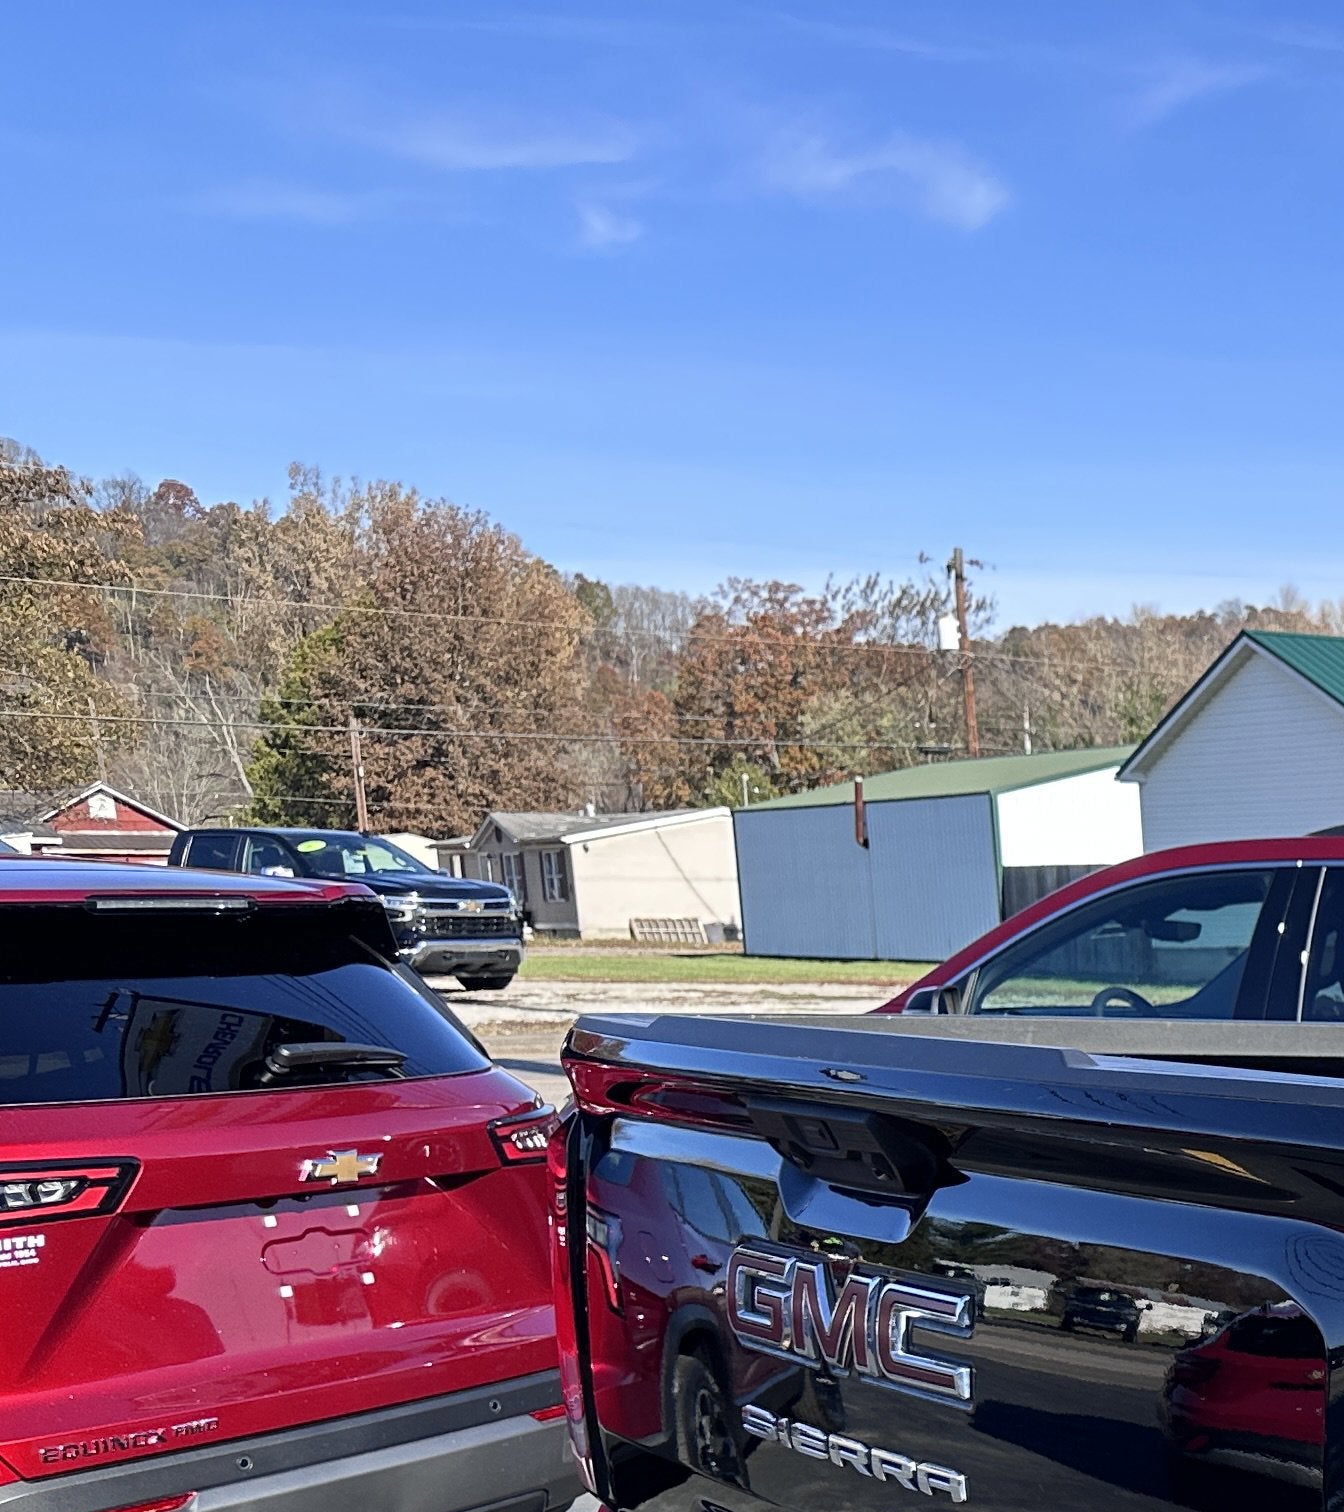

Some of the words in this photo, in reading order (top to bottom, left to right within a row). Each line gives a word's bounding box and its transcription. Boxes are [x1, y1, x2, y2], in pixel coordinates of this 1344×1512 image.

[0, 1234, 46, 1251] ITH
[727, 1242, 976, 1409] GMC
[39, 1427, 167, 1463] EQUINOX
[741, 1404, 968, 1503] SIERRA
